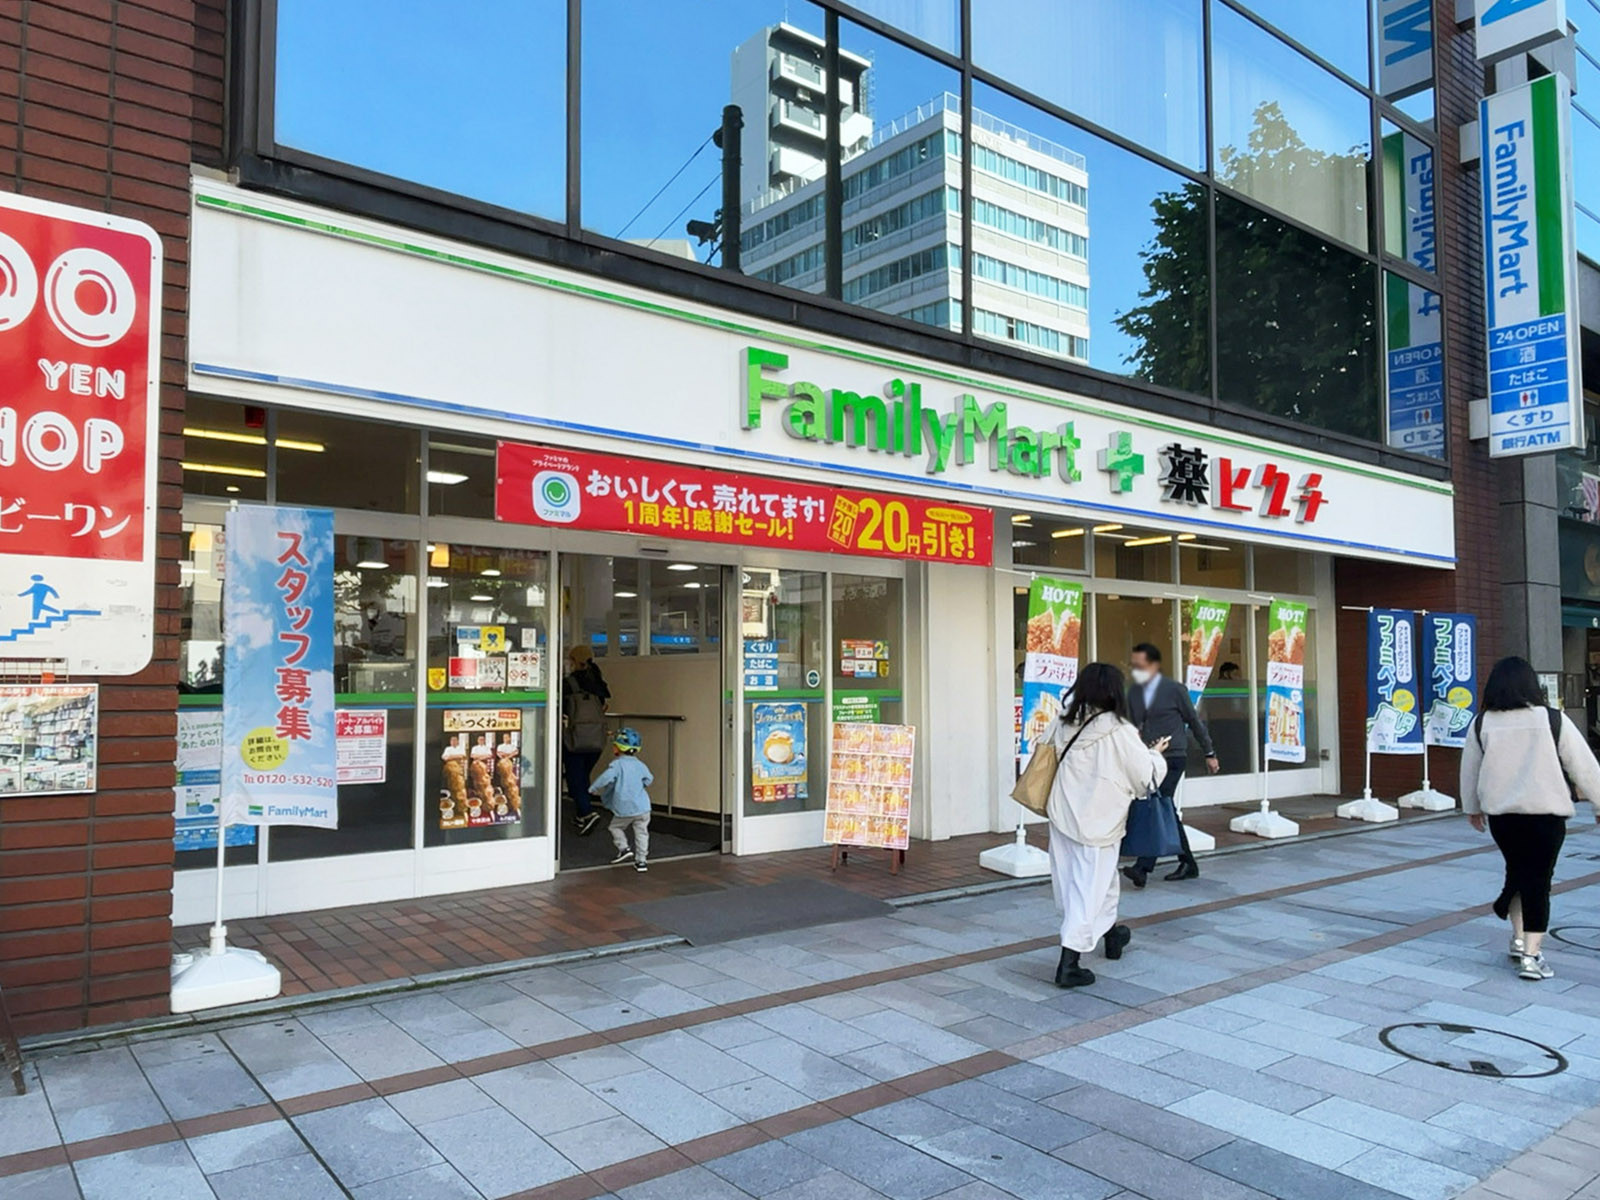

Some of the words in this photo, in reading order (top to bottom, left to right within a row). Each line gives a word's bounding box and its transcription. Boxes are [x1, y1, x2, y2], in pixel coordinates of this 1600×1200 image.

[1492, 120, 1530, 298] FamilyMart
[1519, 345, 1536, 363] 酒
[38, 358, 125, 400] YEN
[741, 346, 1082, 483] FamilyMart
[1506, 409, 1554, 427] くすり
[1501, 431, 1561, 450] 銀行ATM
[832, 511, 853, 536] 20
[1041, 585, 1079, 605] HOT!
[1196, 606, 1227, 622] HOT!
[1277, 607, 1305, 623] HOT!
[277, 531, 312, 740] スタッフ募集
[750, 642, 773, 653] くすり
[749, 659, 773, 669] たばこ
[1377, 615, 1396, 701] ファミペイ
[1431, 617, 1454, 698] ファミペイ
[268, 805, 329, 818] FamilyMart
